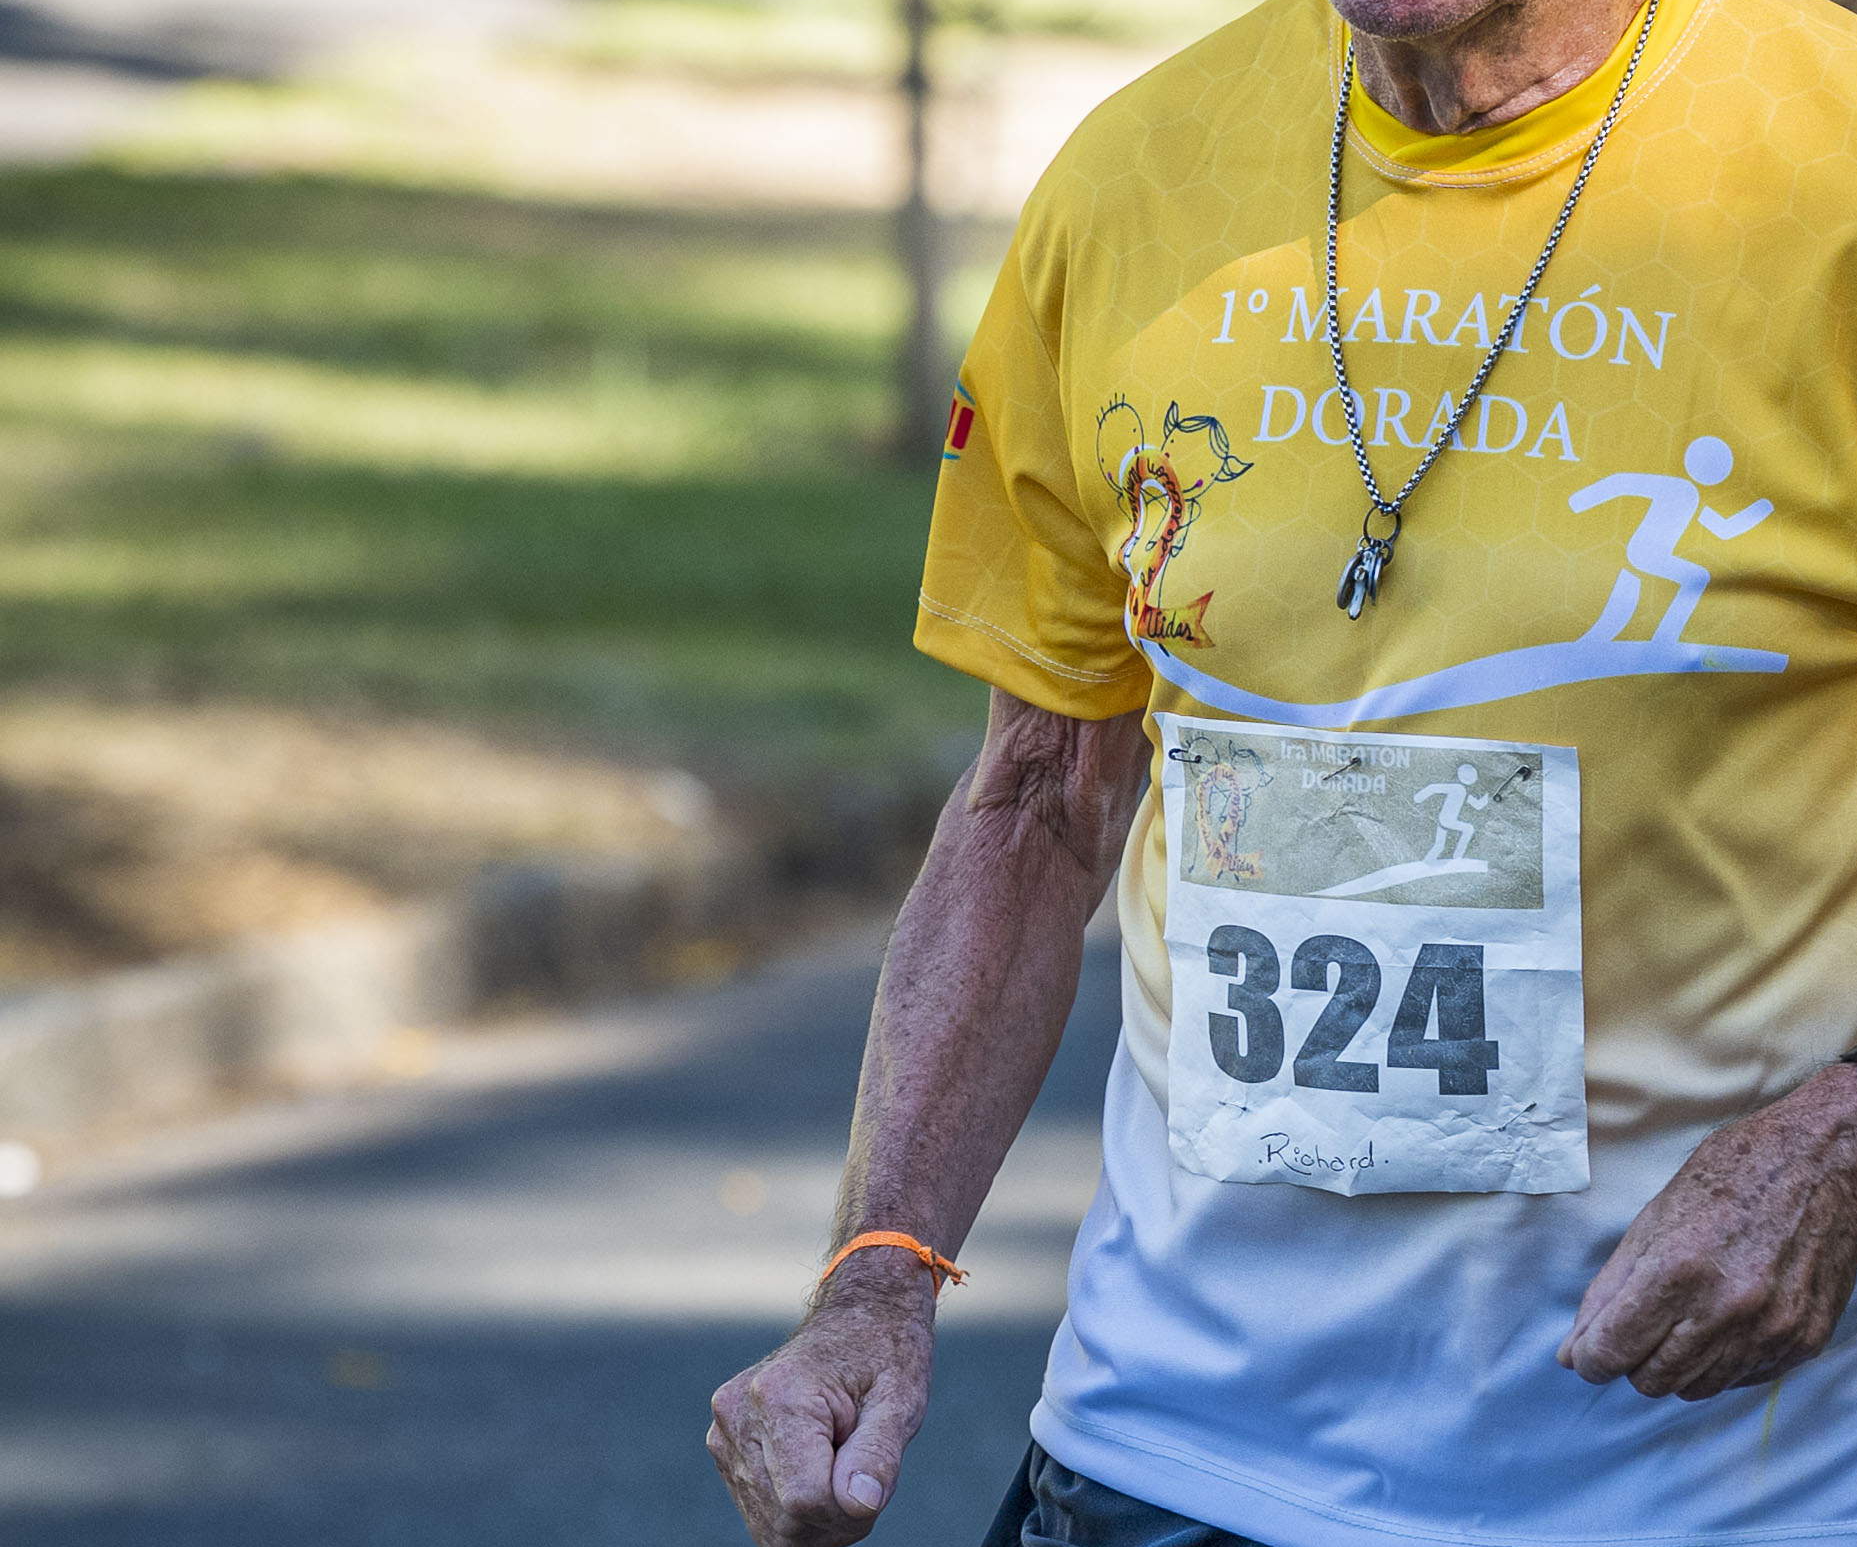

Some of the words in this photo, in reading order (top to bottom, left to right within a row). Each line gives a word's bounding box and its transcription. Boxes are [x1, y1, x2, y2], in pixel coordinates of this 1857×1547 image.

[1280, 283, 1677, 371] MARATÓN
[1252, 384, 1581, 462] DORADA
[1206, 924, 1500, 1096] 324
